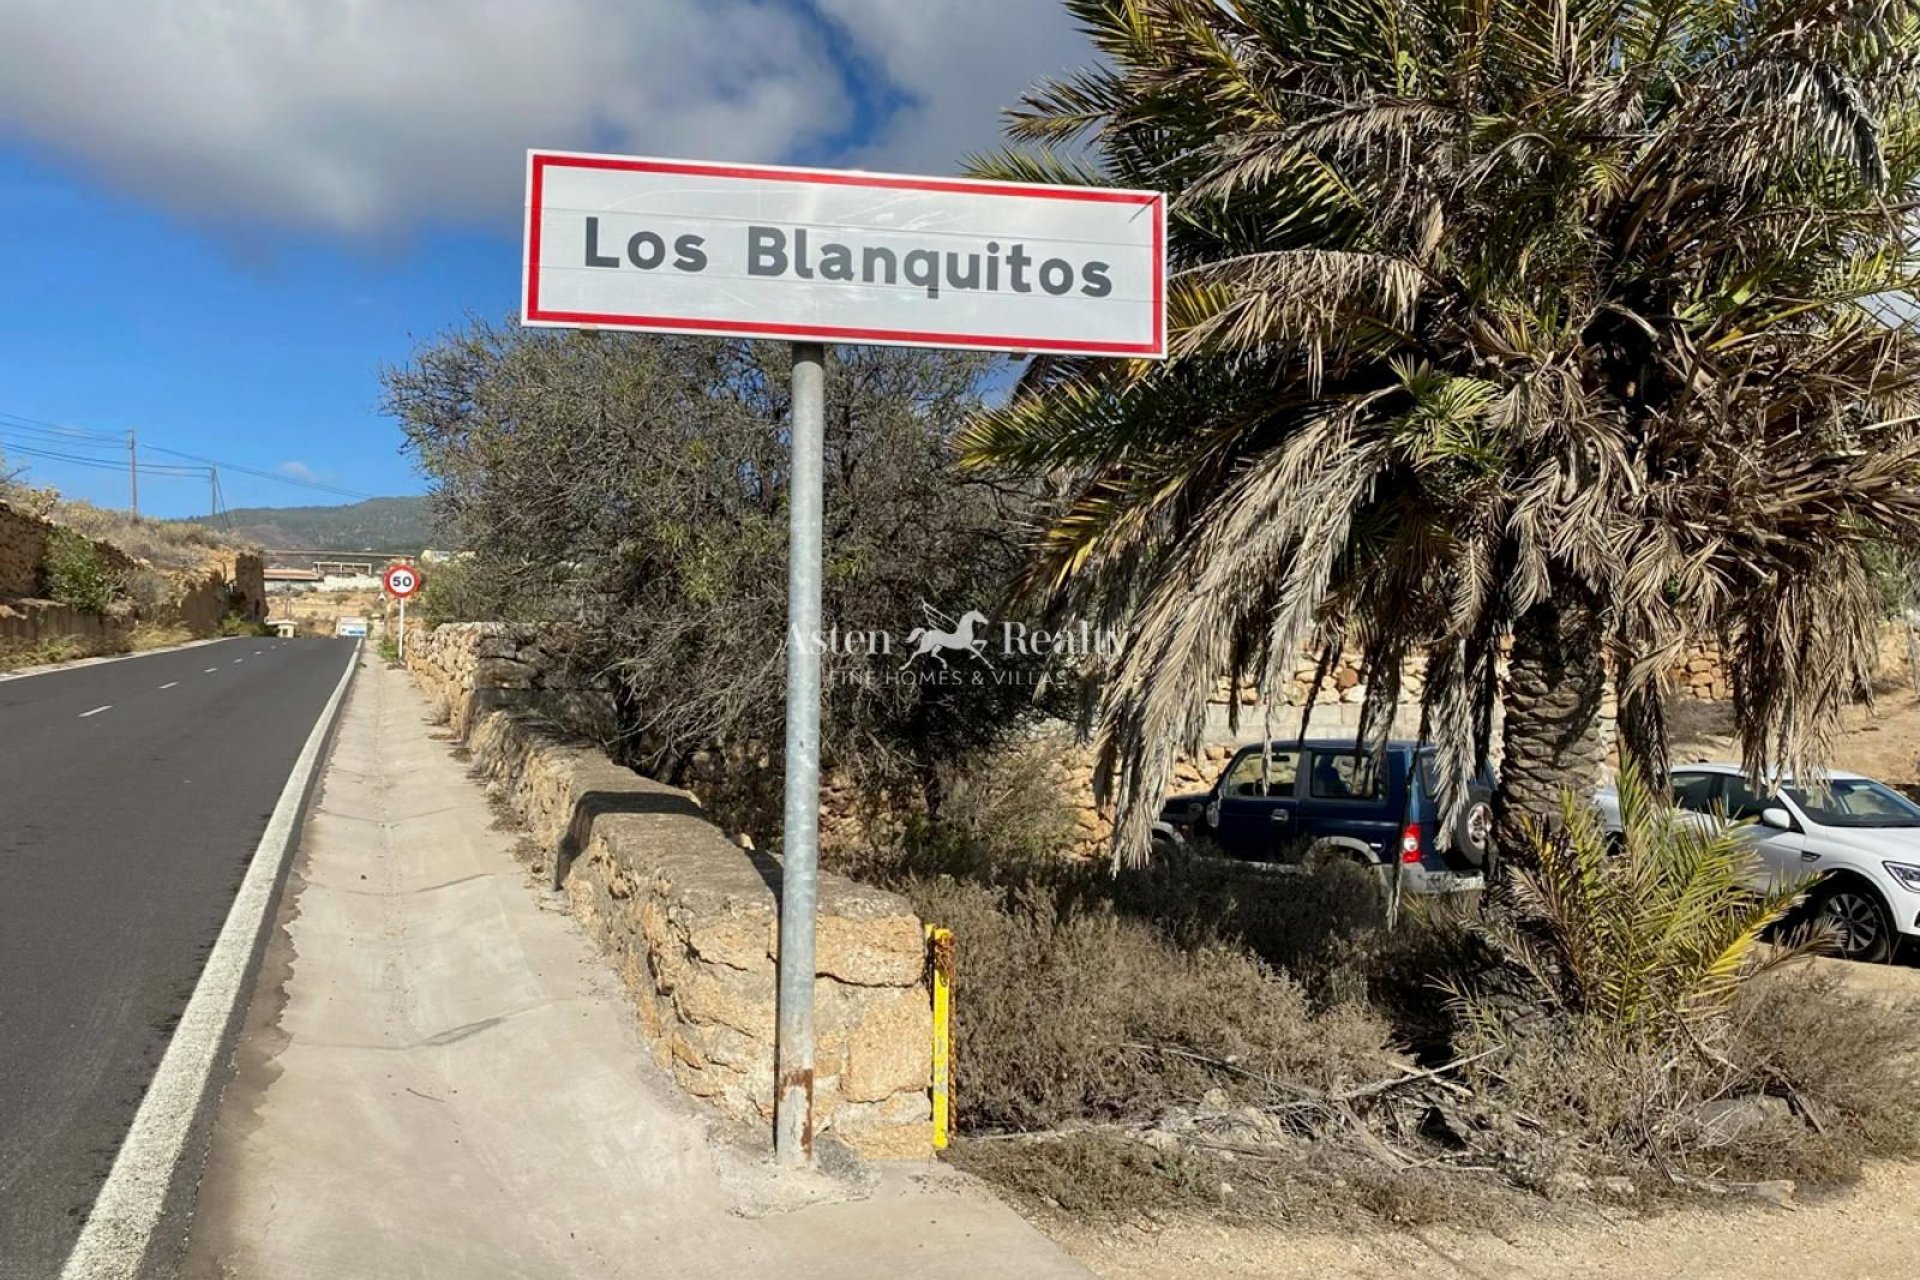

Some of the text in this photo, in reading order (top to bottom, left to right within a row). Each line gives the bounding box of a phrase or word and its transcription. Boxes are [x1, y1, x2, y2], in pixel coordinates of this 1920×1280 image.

[584, 216, 1112, 299] Los Blanquitos
[392, 576, 412, 587] 50
